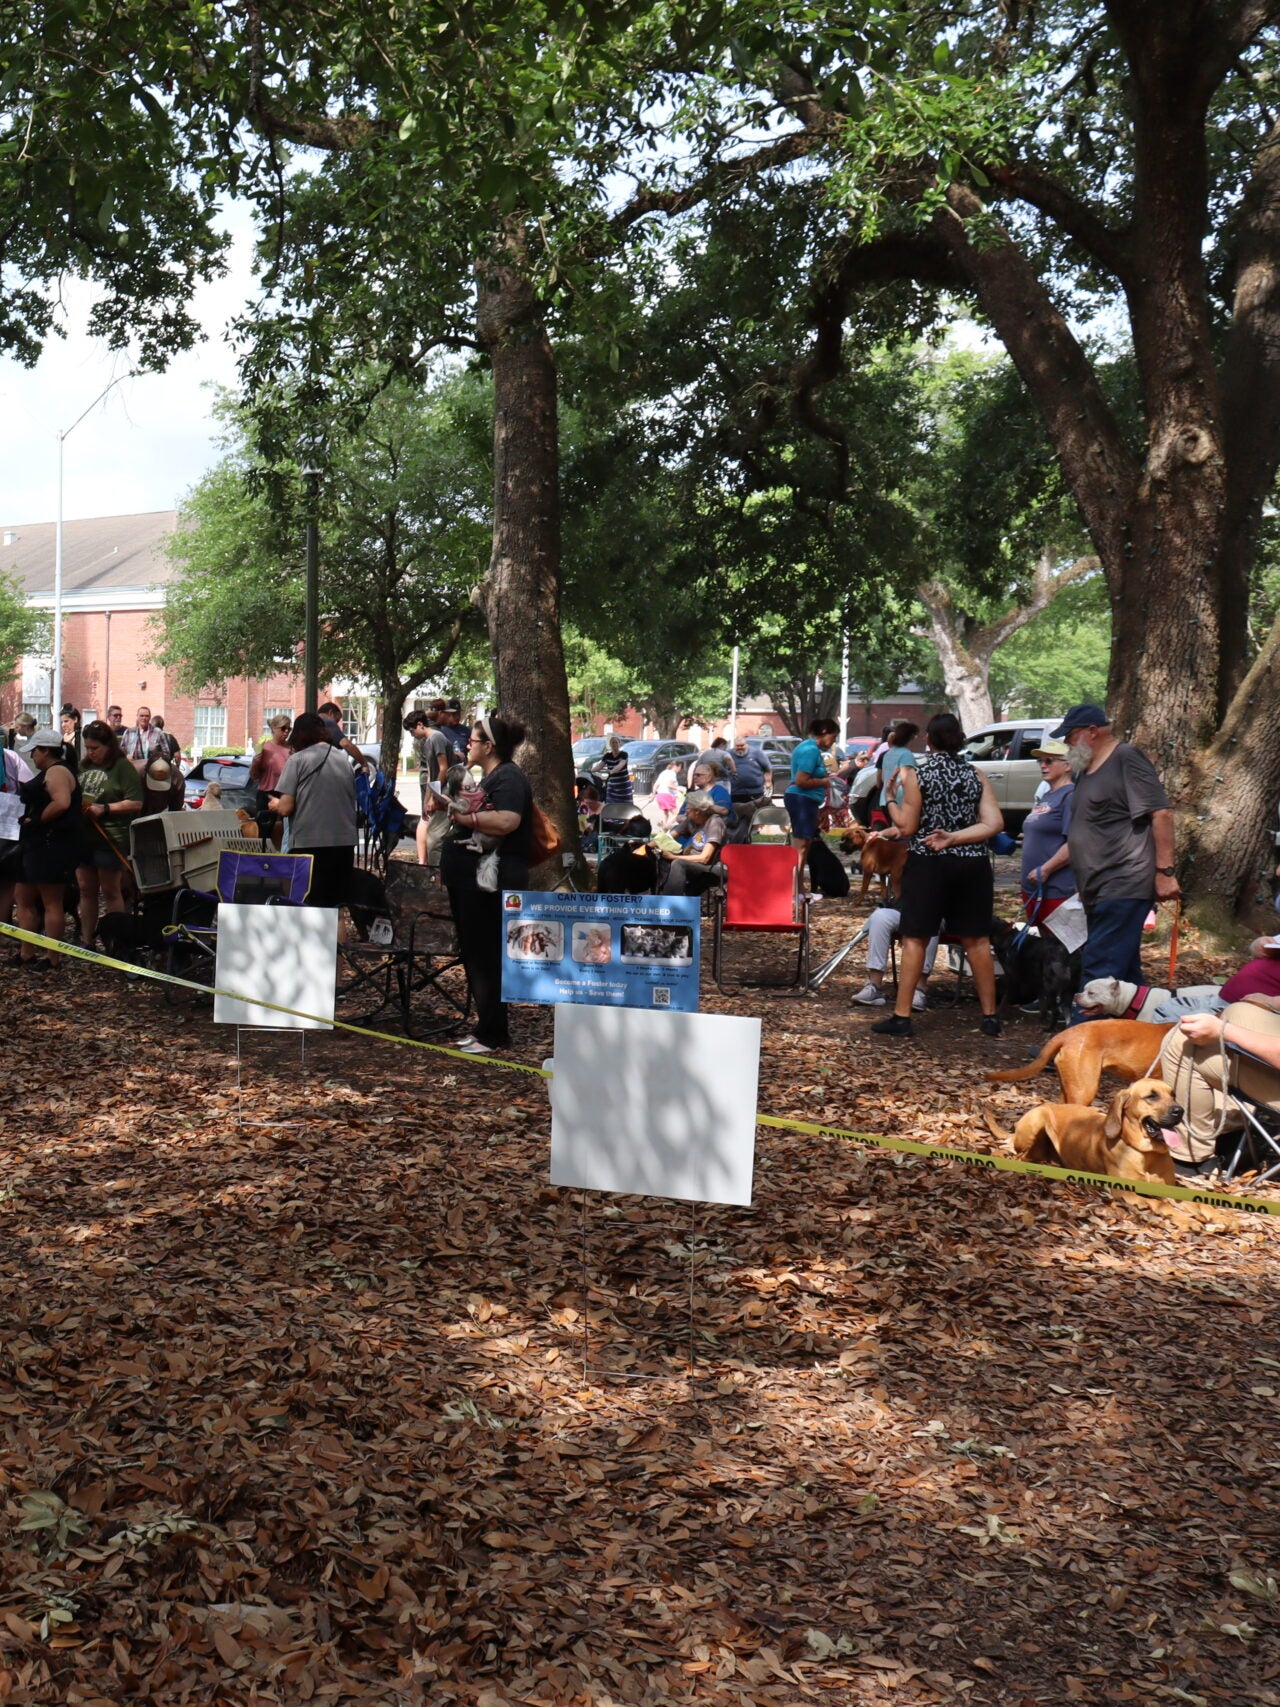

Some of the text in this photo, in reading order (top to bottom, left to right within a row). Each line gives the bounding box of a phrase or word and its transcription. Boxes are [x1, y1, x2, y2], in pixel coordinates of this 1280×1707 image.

[557, 893, 643, 903] CAN YOU FOSTER?
[530, 903, 543, 911] WE
[544, 904, 577, 912] PROVIDE
[579, 905, 628, 914] EVERYTHING
[630, 907, 647, 915] YOU
[648, 908, 671, 916] NEED
[554, 978, 581, 986] Become
[609, 981, 628, 989] today
[559, 987, 574, 996] Help
[588, 989, 605, 997] Save
[605, 990, 625, 998] them!
